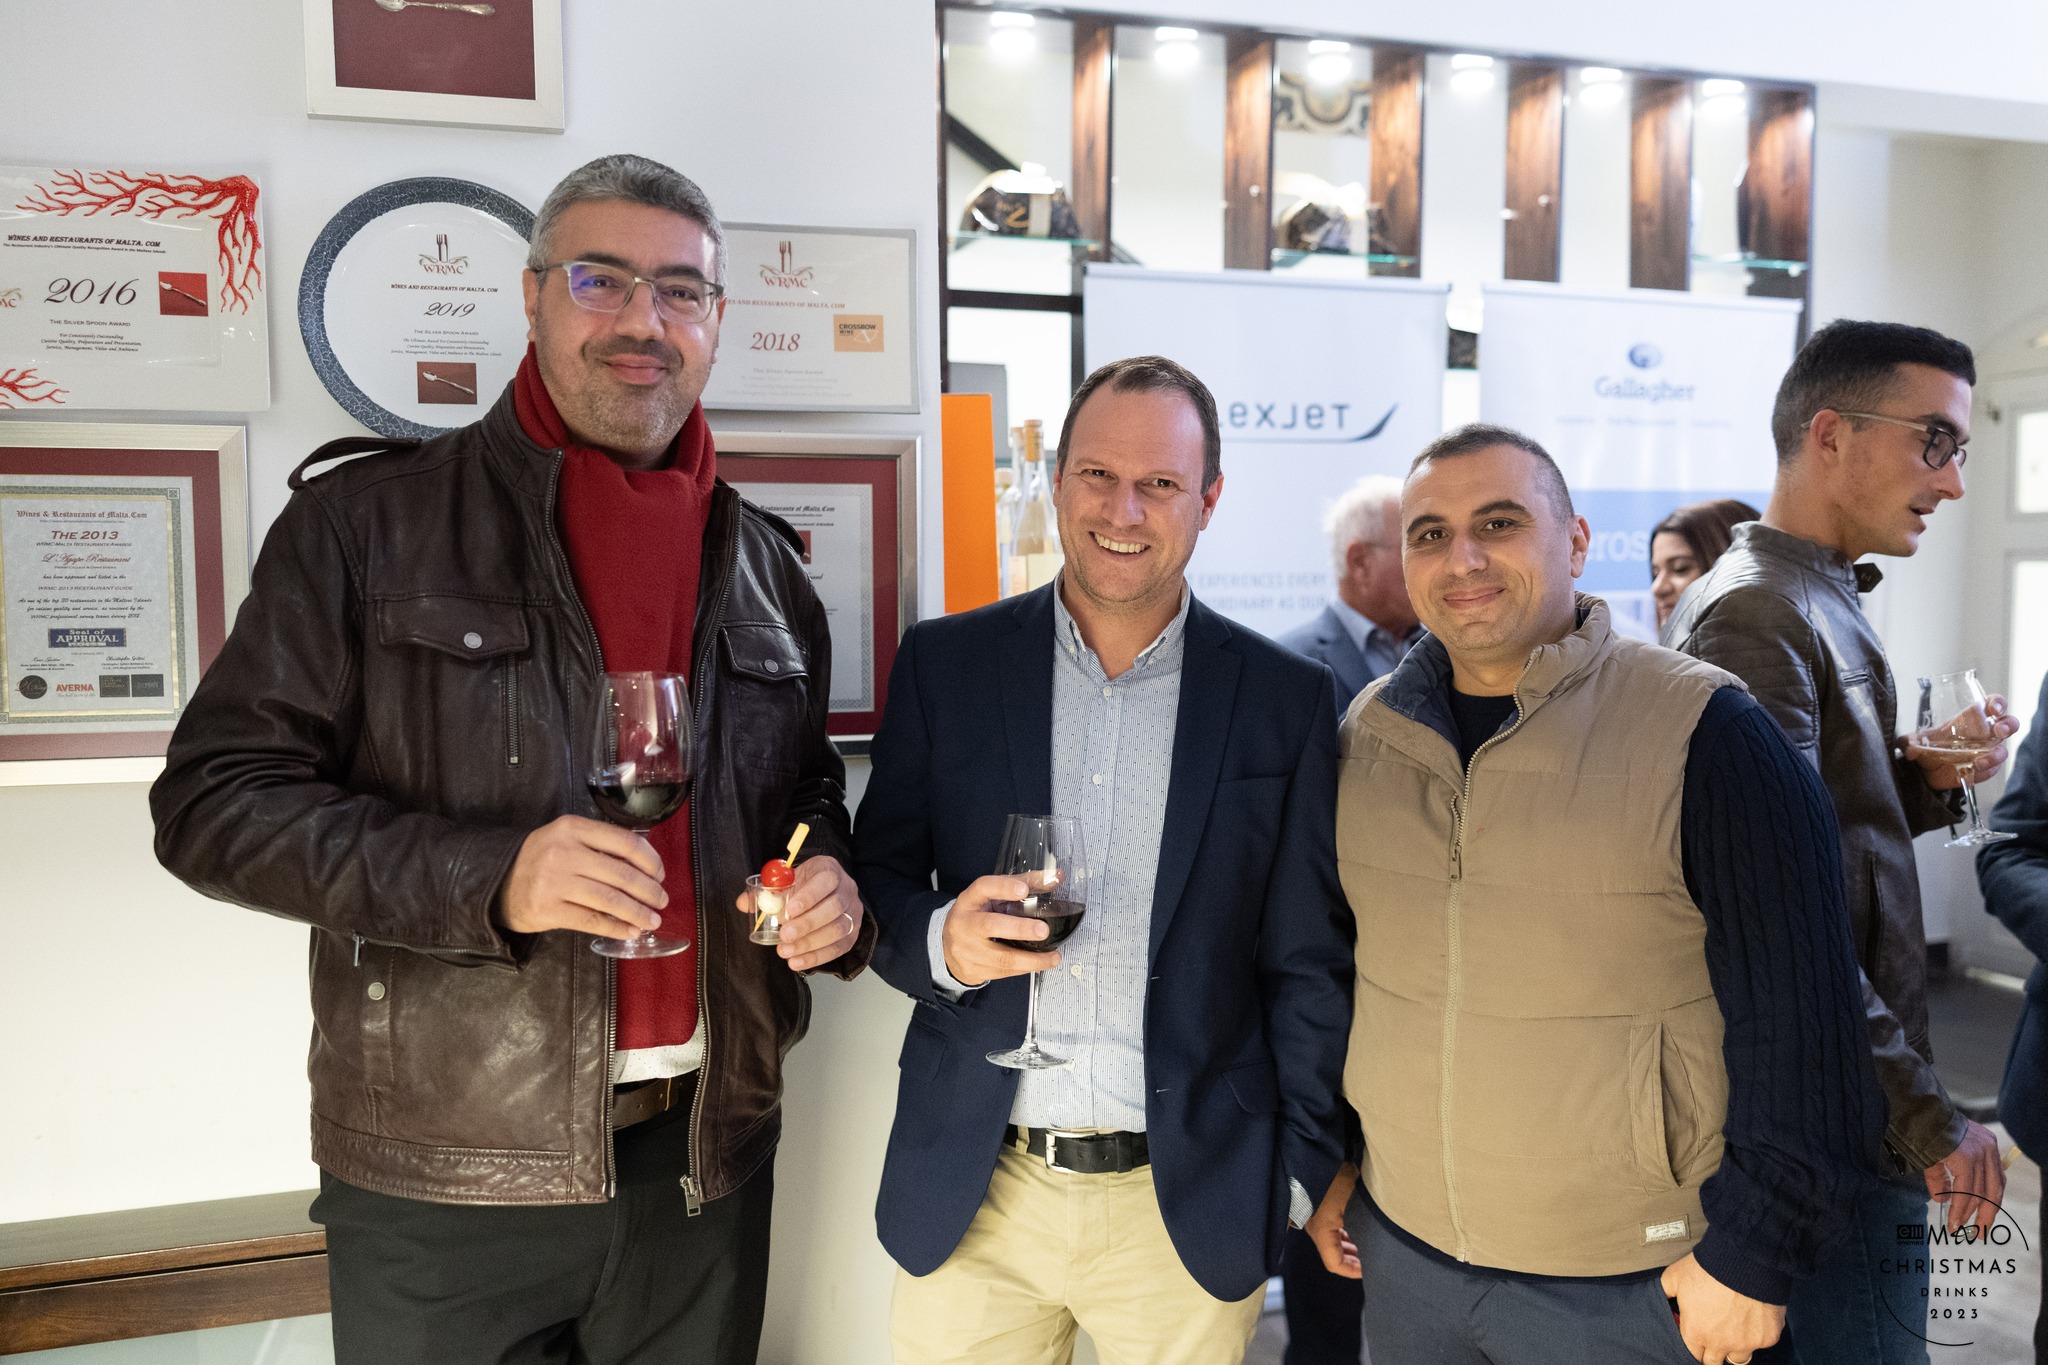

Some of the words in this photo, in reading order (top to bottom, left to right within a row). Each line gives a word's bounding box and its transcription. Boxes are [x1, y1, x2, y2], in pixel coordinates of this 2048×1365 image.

[8, 234, 31, 242] WINES
[49, 236, 104, 245] RESTAURANTS
[422, 264, 464, 276] WRMC
[764, 276, 808, 289] WRMC
[44, 277, 139, 306] 2016
[424, 302, 476, 317] 2019
[749, 332, 801, 352] 2018
[1594, 376, 1696, 404] Gallagher
[80, 530, 118, 540] 2013
